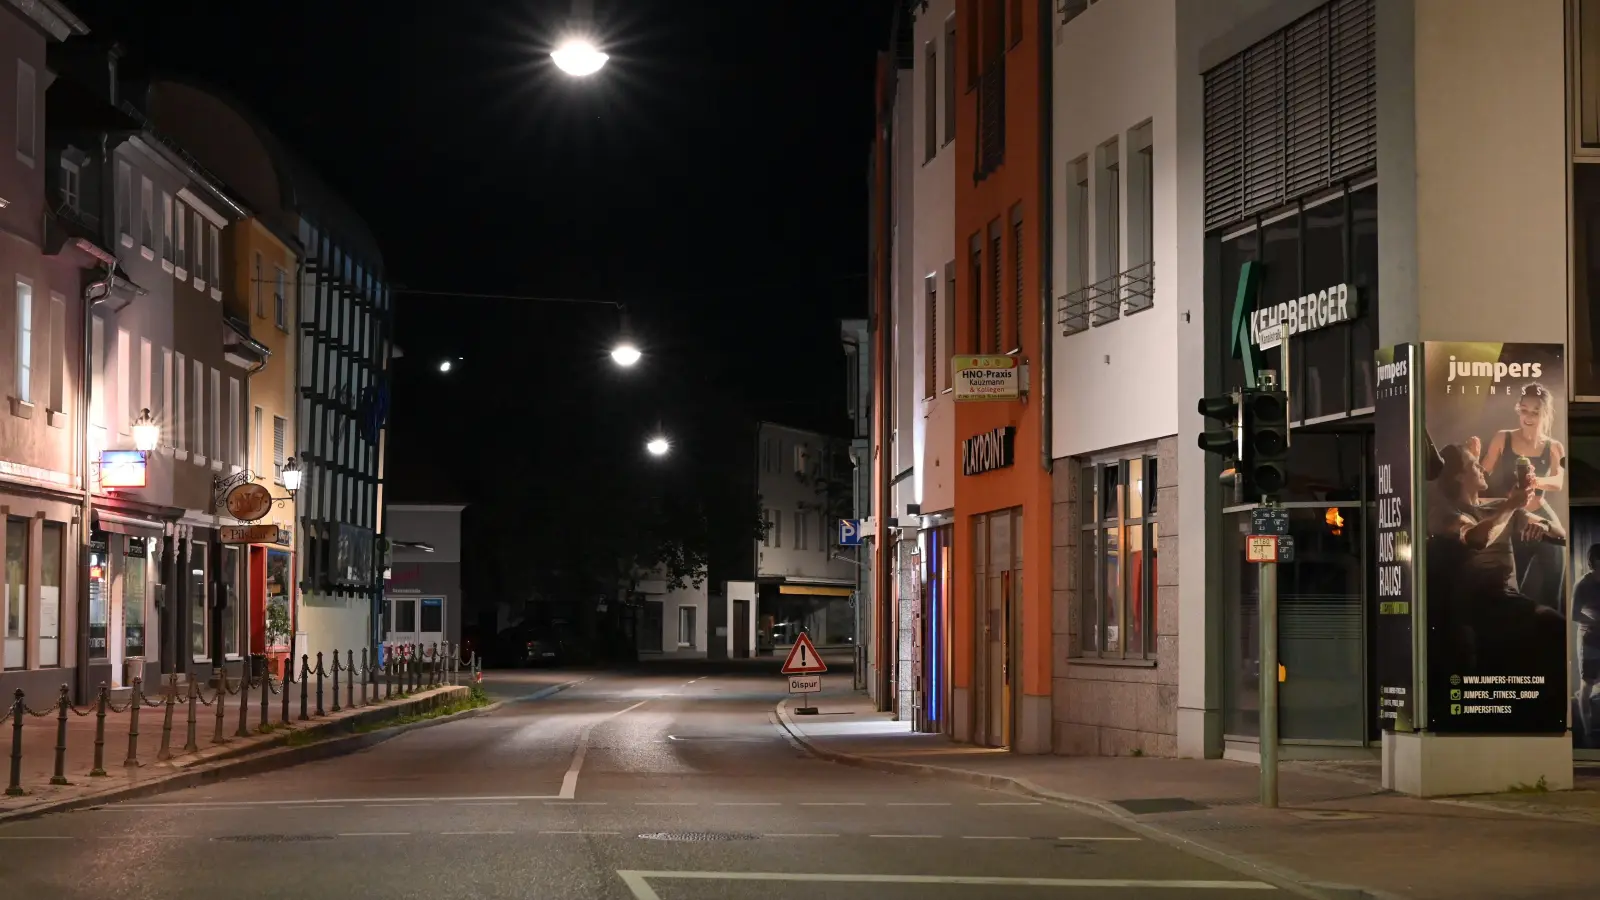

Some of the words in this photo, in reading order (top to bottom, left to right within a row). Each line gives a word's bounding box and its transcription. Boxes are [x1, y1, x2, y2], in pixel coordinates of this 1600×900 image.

[962, 370, 1012, 379] HNO-Praxis
[1376, 360, 1407, 388] jumpers
[1447, 355, 1543, 383] jumpers
[969, 378, 1005, 386] Kauzmann
[1446, 385, 1542, 396] FITNESS
[962, 427, 1006, 476] PLAYPOINT
[1378, 464, 1394, 495] HOL
[1378, 497, 1402, 529] ALLES
[841, 525, 856, 543] P
[1379, 532, 1394, 563] AUS
[1379, 566, 1402, 597] RAUS!
[791, 680, 818, 690] Ölspur
[1463, 675, 1545, 685] WWW.JUMPERS-FITNESS.COM
[1463, 690, 1540, 700] JUMPERS_FITNESS_GROUP
[1463, 705, 1512, 714] JUMPERSFITNESS
